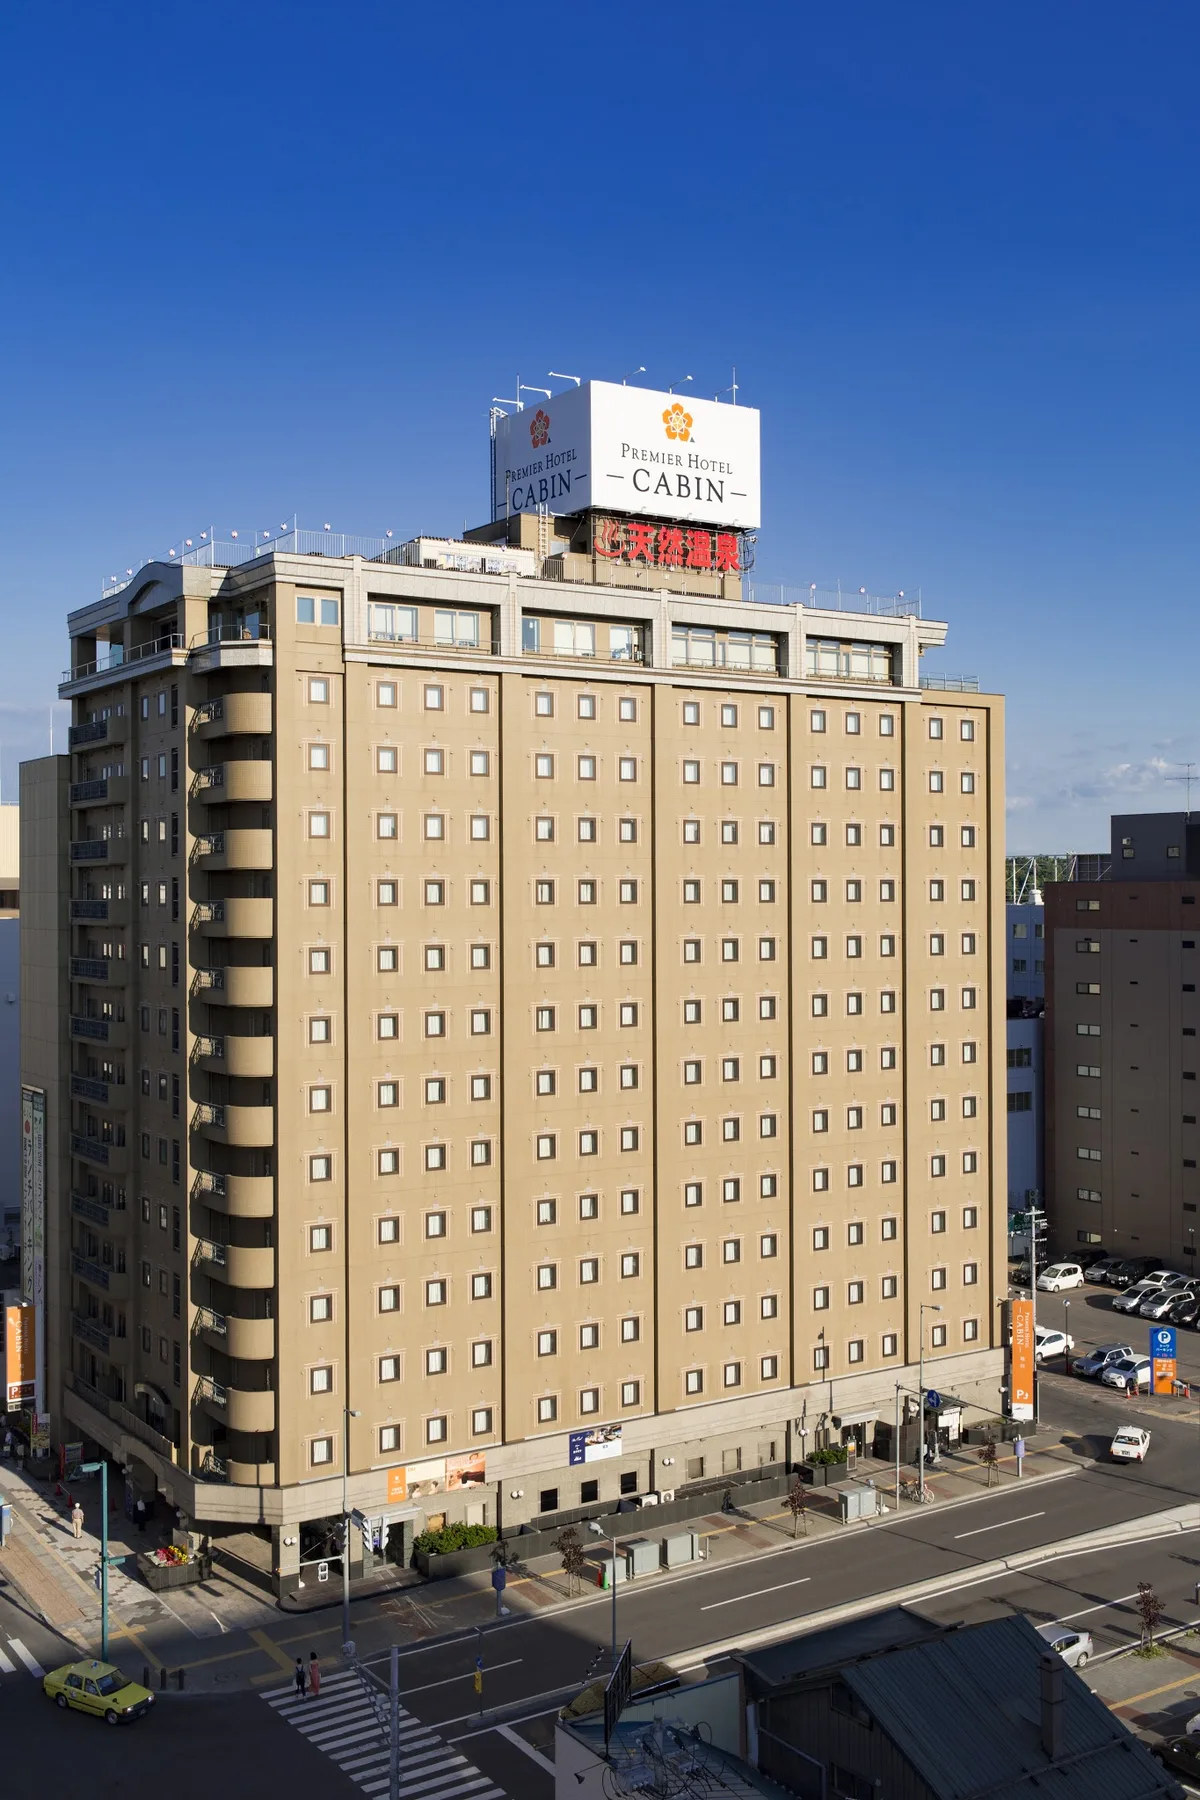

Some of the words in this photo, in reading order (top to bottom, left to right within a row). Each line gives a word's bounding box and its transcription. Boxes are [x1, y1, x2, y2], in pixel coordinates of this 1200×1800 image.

[505, 461, 544, 484] PREMIER
[545, 448, 577, 470] HOTEL
[621, 442, 683, 467] PREMIER
[687, 453, 733, 475] HOTEL
[512, 469, 572, 511] CABIN
[632, 468, 725, 504] CABIN
[627, 523, 741, 571] 天然温泉
[15, 1320, 23, 1353] CABIN
[1016, 1314, 1024, 1345] CABIN
[12, 1386, 19, 1396] P
[1016, 1389, 1024, 1399] P
